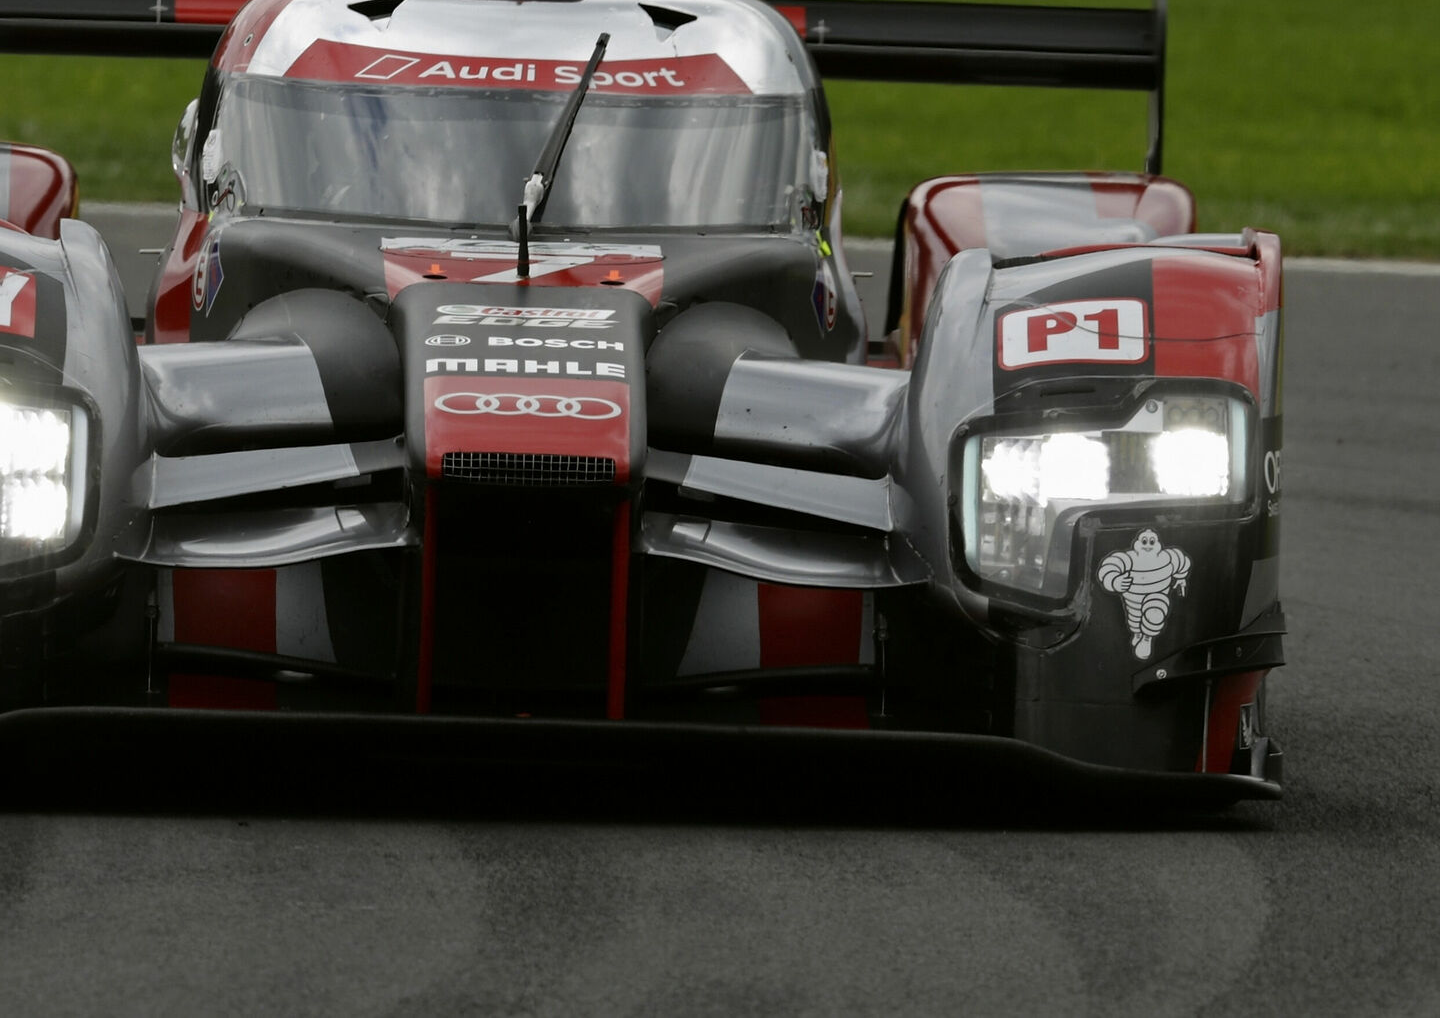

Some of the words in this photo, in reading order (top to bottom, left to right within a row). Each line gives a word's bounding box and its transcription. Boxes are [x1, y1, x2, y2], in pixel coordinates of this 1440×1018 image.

[418, 61, 535, 81] Audi
[554, 66, 685, 89] Sport
[432, 315, 620, 329] EDGE
[1027, 308, 1120, 353] P1
[488, 337, 625, 351] BOSCH
[425, 358, 626, 378] MAHLE
